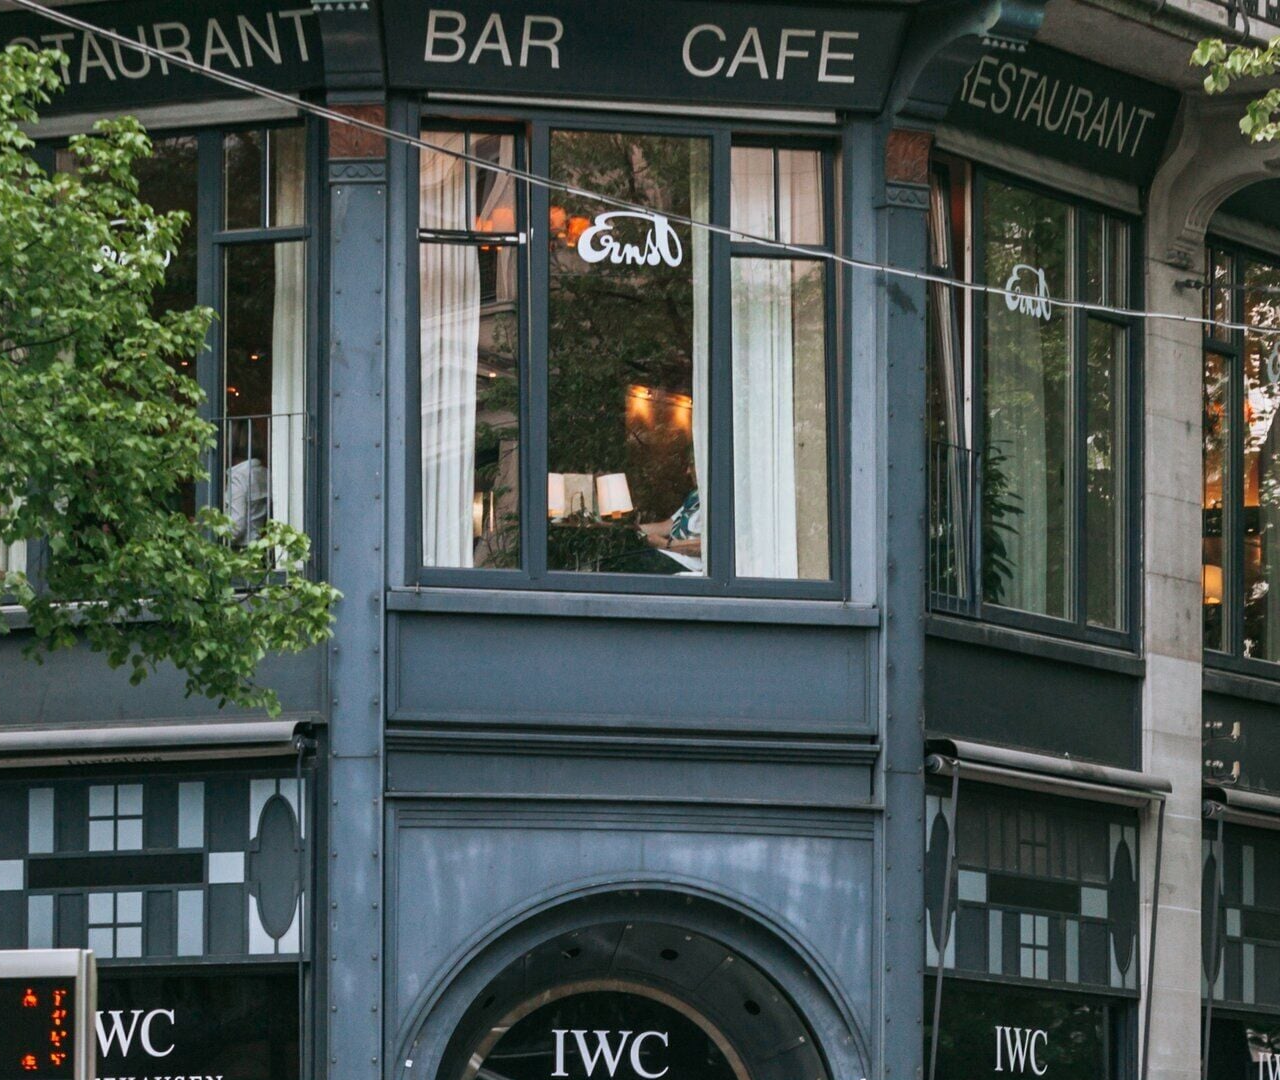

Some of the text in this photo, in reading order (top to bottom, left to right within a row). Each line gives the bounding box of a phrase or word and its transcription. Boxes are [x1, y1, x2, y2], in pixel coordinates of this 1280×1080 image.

[423, 9, 860, 84] BAR CAFE
[577, 210, 683, 268] Ernst
[95, 1008, 175, 1058] WC
[551, 1029, 670, 1080] IWC
[994, 1025, 1049, 1076] IWC
